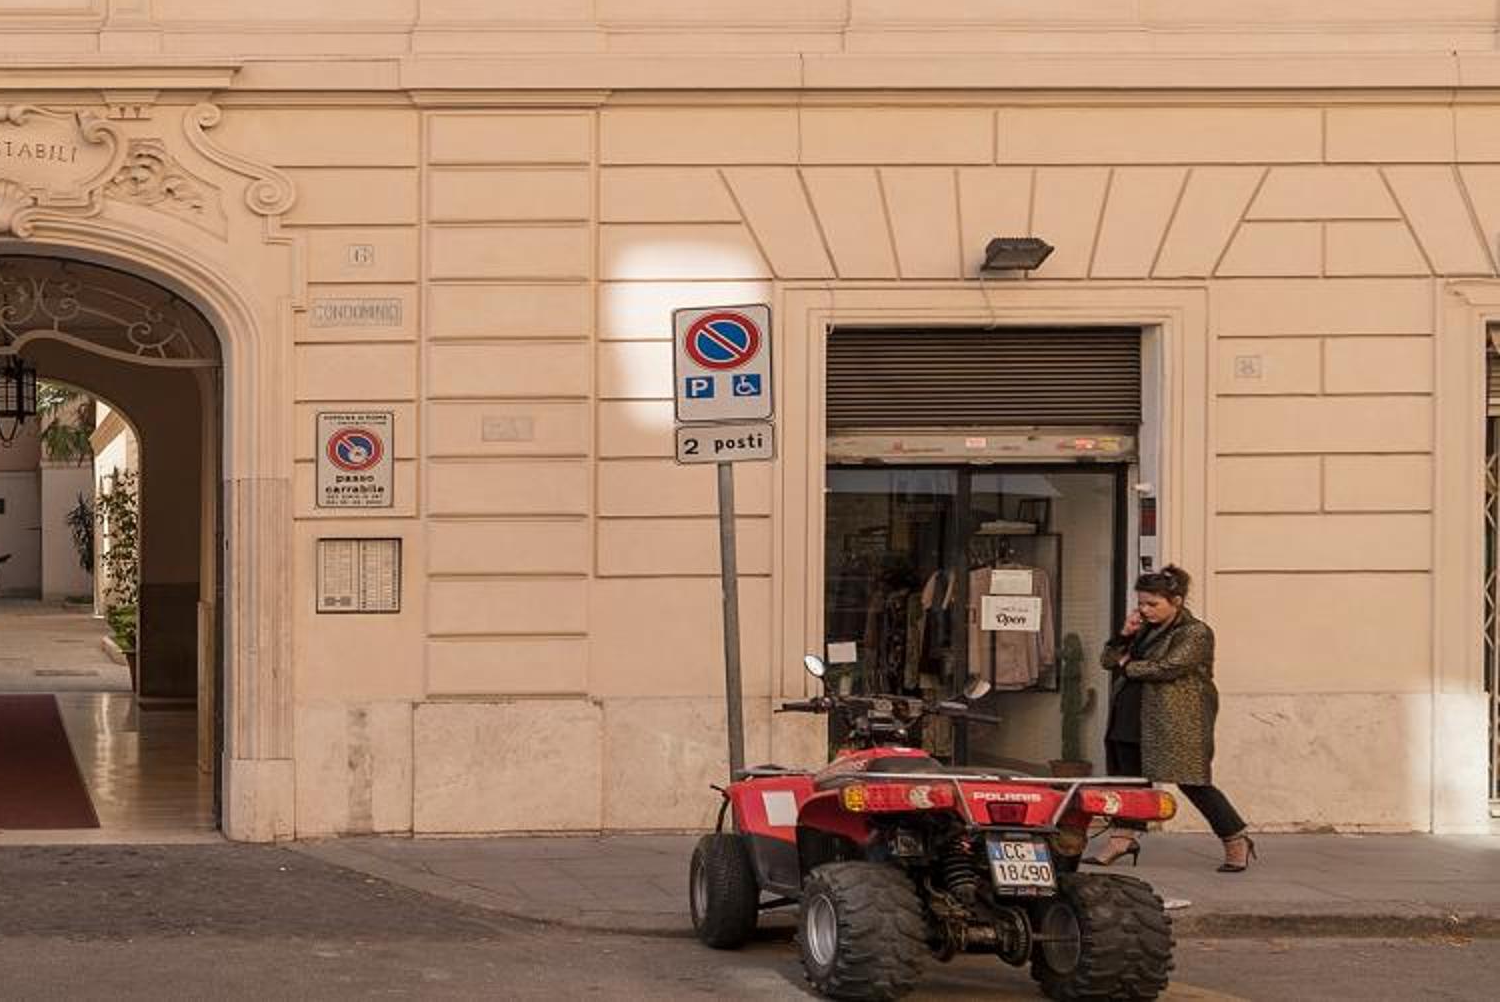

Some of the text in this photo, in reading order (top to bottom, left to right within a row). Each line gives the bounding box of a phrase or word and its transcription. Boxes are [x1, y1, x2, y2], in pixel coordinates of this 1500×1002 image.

[691, 379, 709, 397] P
[683, 433, 763, 455] 2 posti
[335, 474, 375, 483] passo
[325, 484, 385, 494] carrabile
[972, 791, 1043, 802] POLARIS
[999, 863, 1051, 882] 18490
